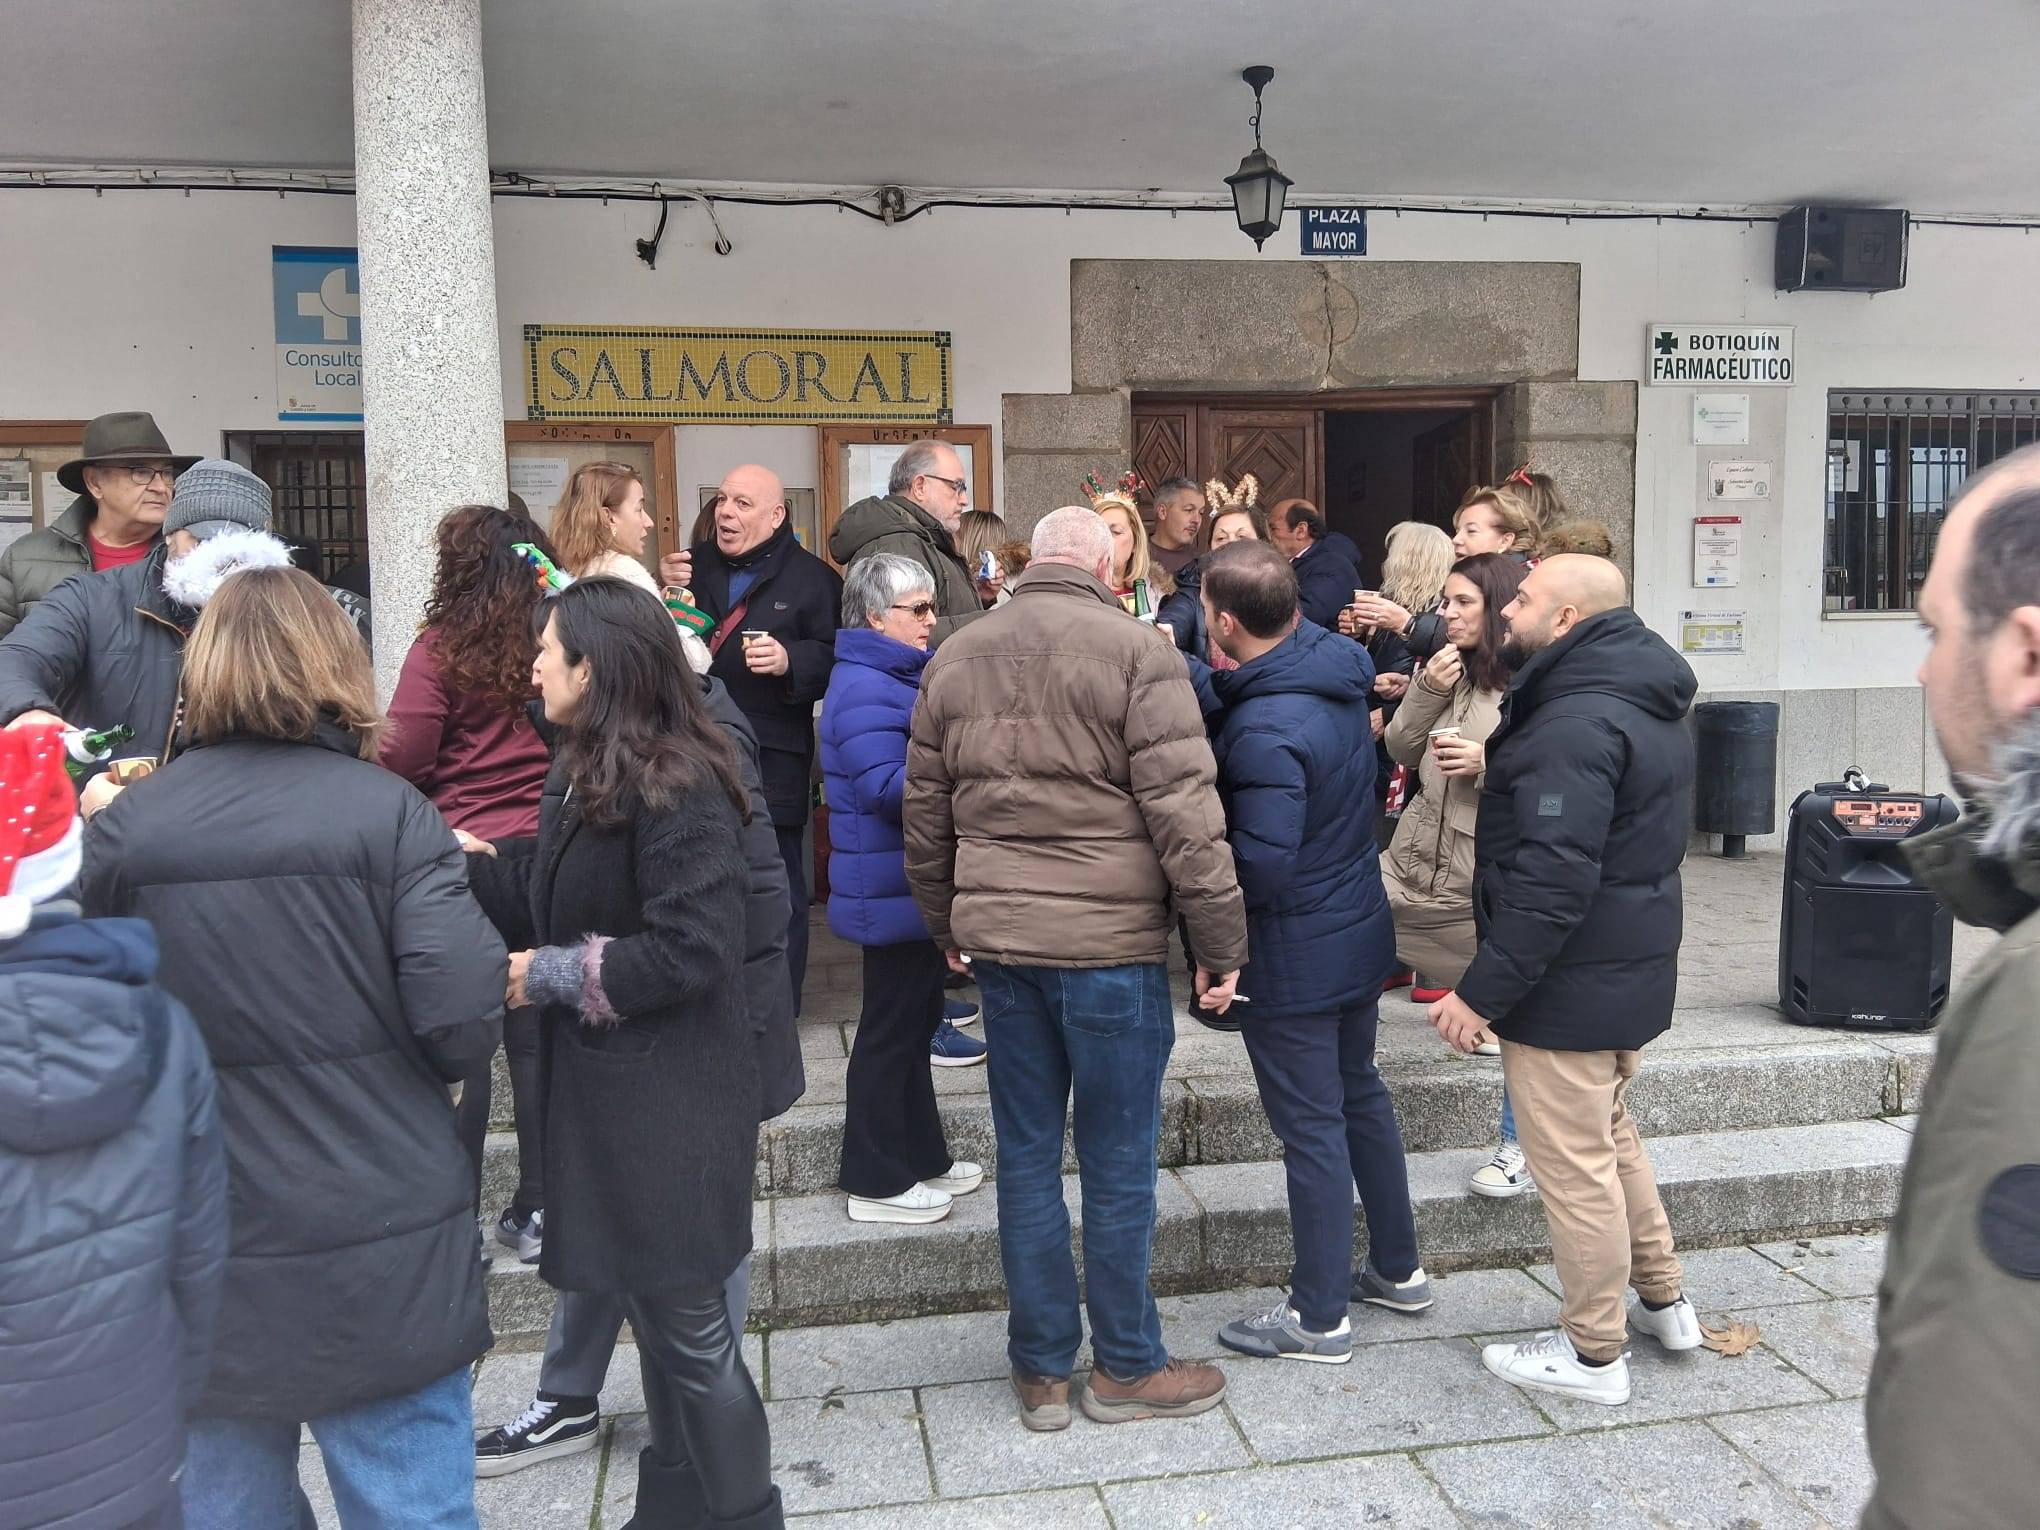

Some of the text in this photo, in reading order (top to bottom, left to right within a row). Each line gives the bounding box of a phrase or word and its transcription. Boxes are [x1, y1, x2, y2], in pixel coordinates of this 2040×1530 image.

[1308, 209, 1361, 224] PLAZA
[1312, 231, 1357, 250] MAYOR
[1689, 332, 1780, 352] BOTIQUÍN
[550, 347, 931, 404] SALMORAL
[1653, 353, 1791, 380] FARMACÉUTICO
[315, 369, 361, 386] Local
